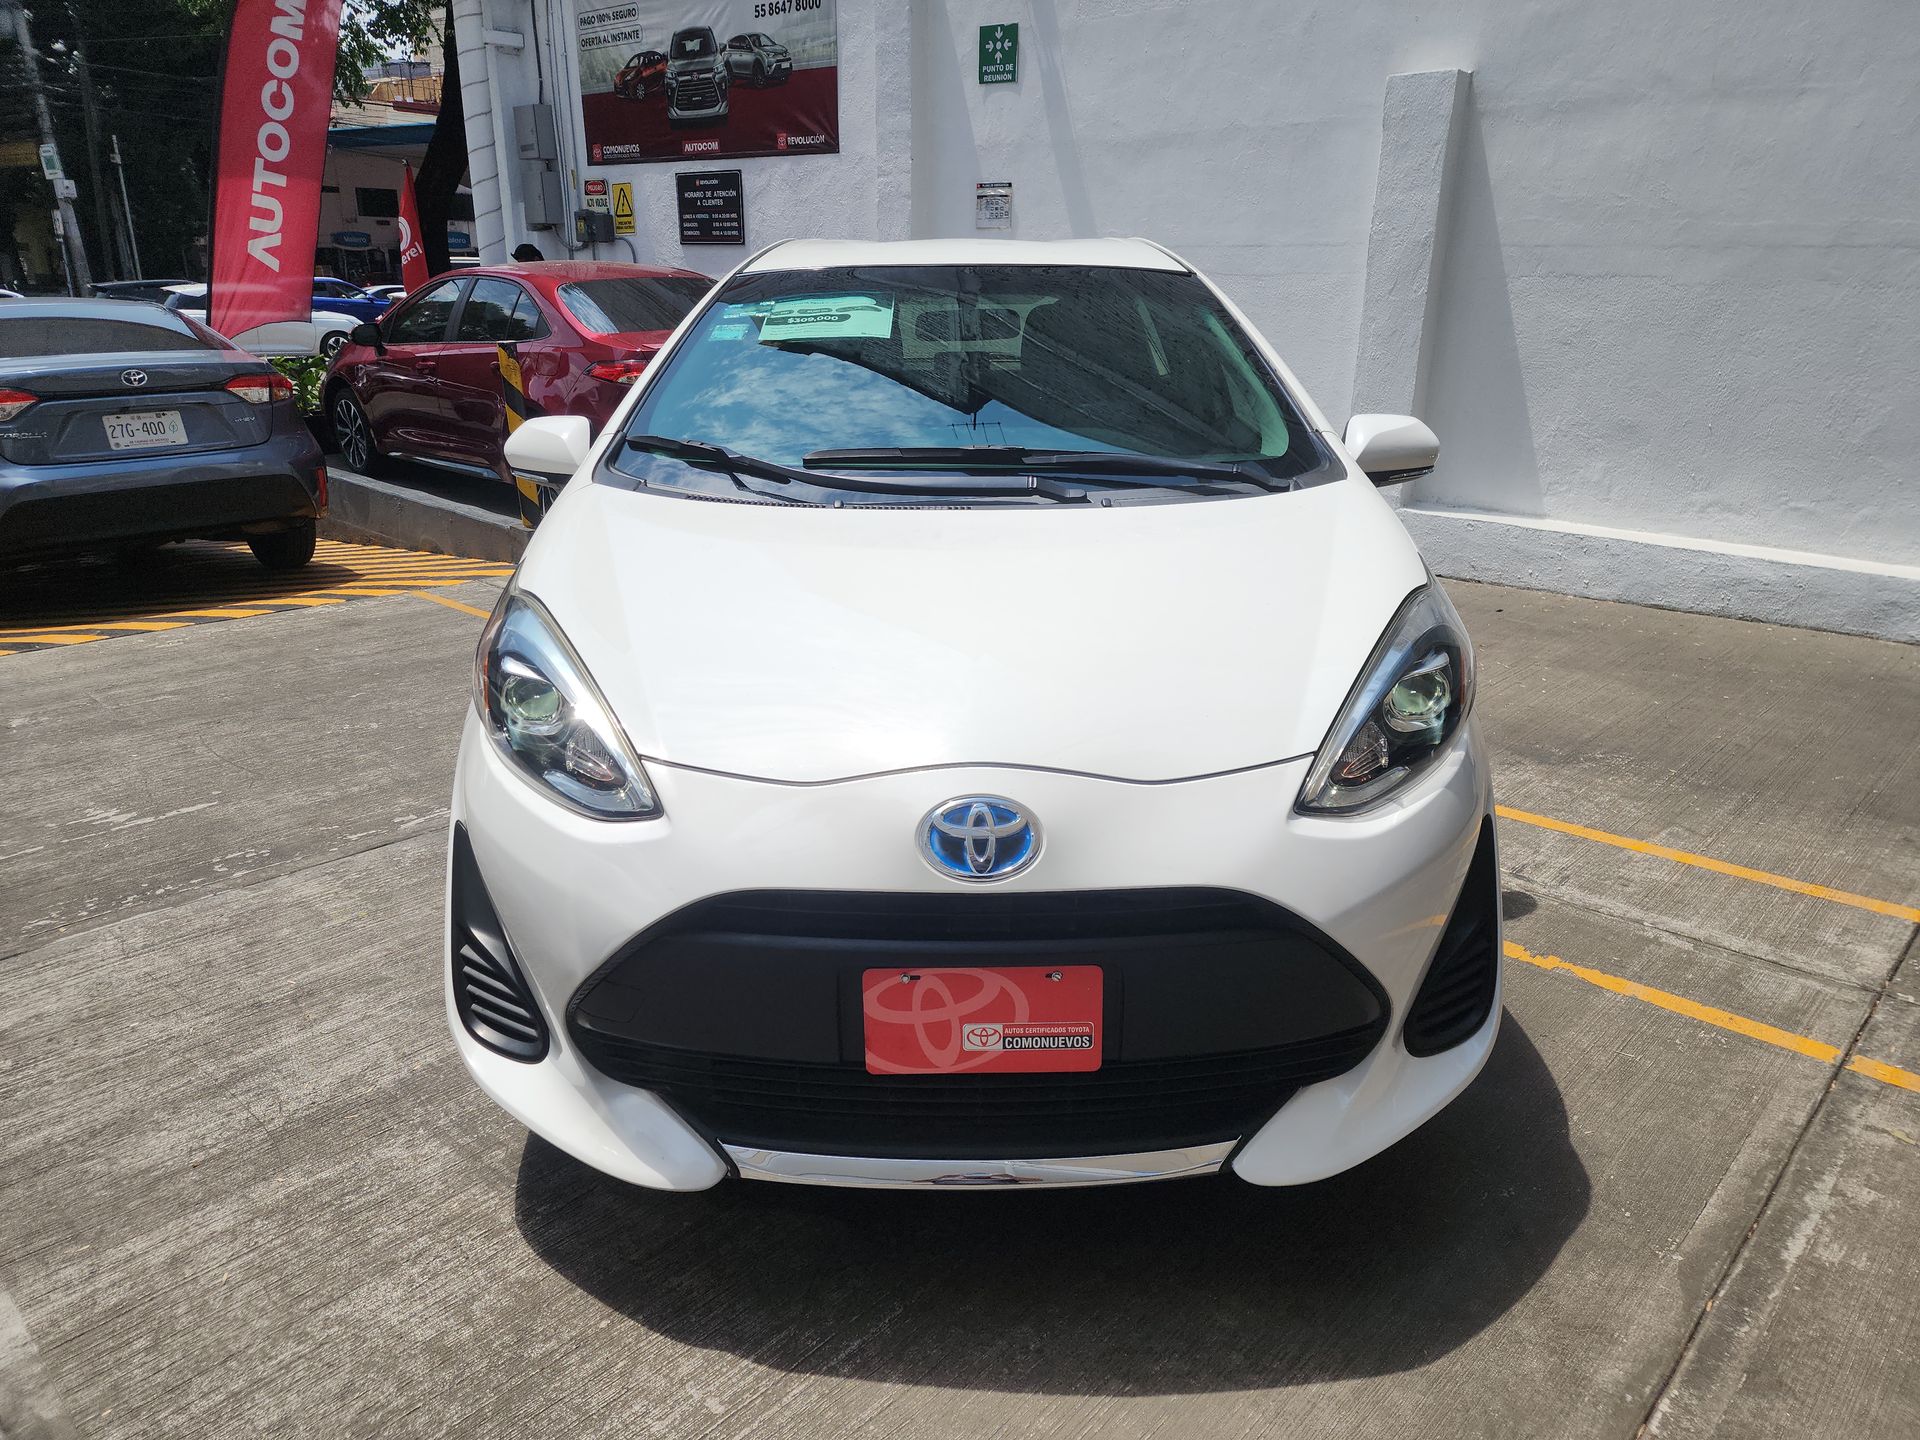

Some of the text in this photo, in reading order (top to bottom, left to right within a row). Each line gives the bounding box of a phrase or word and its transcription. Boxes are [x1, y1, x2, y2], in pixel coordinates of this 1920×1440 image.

[754, 0, 821, 18] 55 8647 8000
[580, 7, 637, 27] PAGO 100% SEGURO
[581, 29, 640, 48] OFERTA AL INSTANTE
[982, 63, 1014, 73] PUNTO DE
[983, 73, 1012, 82] REUNIÓN
[247, 0, 307, 273] AUTOCOM
[787, 133, 825, 146] REVOLUCIÓN
[602, 143, 640, 154] COMONUEVOS
[684, 141, 719, 152] AUTOCOM
[713, 188, 737, 197] ATENCIÓN
[108, 421, 166, 439] 27G-400
[1004, 1026, 1090, 1035] AUTOS CERTIFICADOS TOYOTA
[1005, 1036, 1090, 1049] COMONUEVOS
